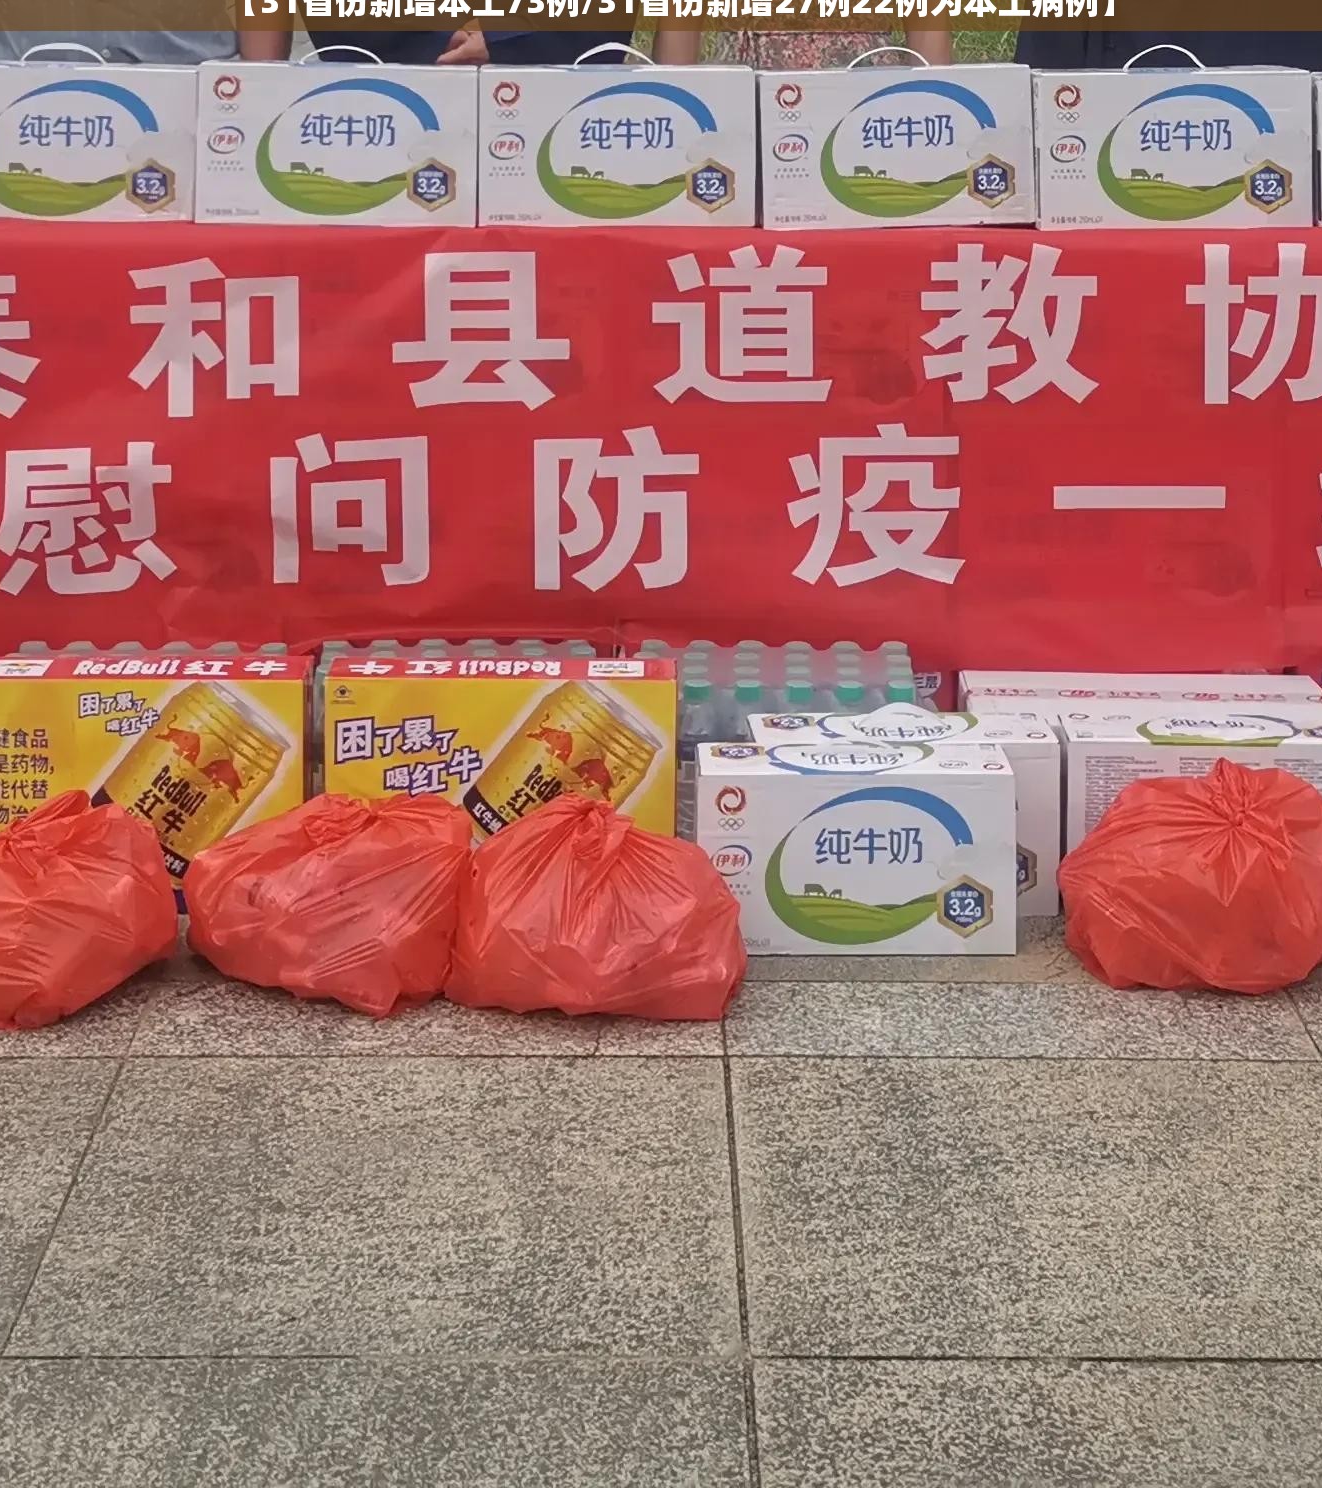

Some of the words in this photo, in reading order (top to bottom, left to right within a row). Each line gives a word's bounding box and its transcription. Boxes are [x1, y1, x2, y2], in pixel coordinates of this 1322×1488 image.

[19, 113, 114, 148] 纯牛奶
[212, 133, 239, 147] 伊利
[300, 113, 395, 147] 纯牛奶
[580, 117, 673, 150] 纯牛奶
[862, 114, 954, 149] 纯牛奶
[1140, 119, 1232, 152] 纯牛奶
[494, 140, 520, 153] 伊利
[777, 141, 803, 154] 伊利
[1055, 142, 1081, 154] 伊利
[136, 178, 165, 196] 3.2g
[416, 176, 445, 195] 3.2g
[696, 178, 725, 196] 3.2g
[977, 174, 1005, 191] 3.2g
[1255, 179, 1283, 197] 3.2g
[73, 659, 180, 676] RedBull
[182, 660, 288, 675] 红牛
[349, 661, 453, 675] 红牛
[458, 660, 562, 676] RedBull
[79, 690, 145, 718] 困了累了
[334, 715, 458, 764] 困了累了
[383, 747, 483, 797] 喝红牛
[152, 765, 207, 817] RedBull
[523, 763, 564, 804] RedB
[134, 789, 185, 833] 红牛
[814, 827, 923, 865] 纯牛奶
[715, 854, 746, 868] 伊利
[948, 898, 982, 919] 3.2g
